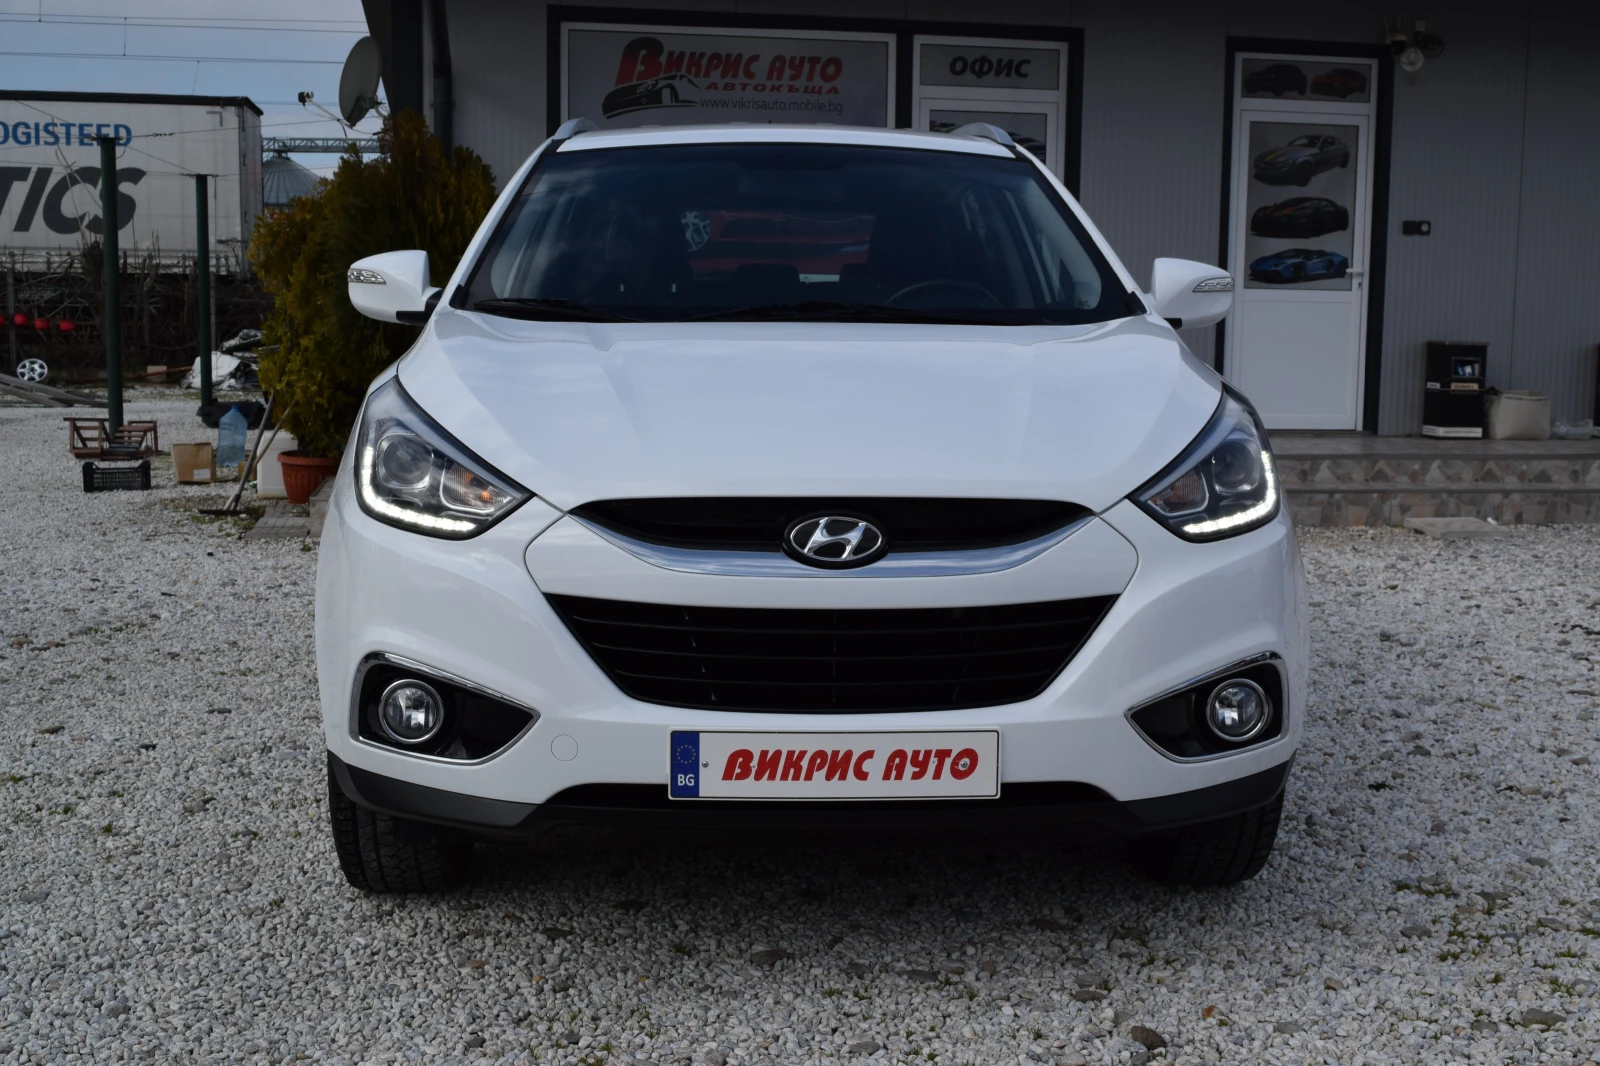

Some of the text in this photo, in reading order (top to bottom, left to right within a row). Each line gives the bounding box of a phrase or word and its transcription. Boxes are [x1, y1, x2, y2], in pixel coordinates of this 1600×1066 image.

[613, 36, 843, 87] ВИКРИС АУТО
[949, 55, 1031, 79] ОФИС
[704, 82, 840, 96] АВТОКЪЩА
[699, 97, 844, 116] www.vikrisauto.mobile.bg
[721, 747, 979, 782] ВИКРИС АУТО
[677, 773, 695, 787] BG
